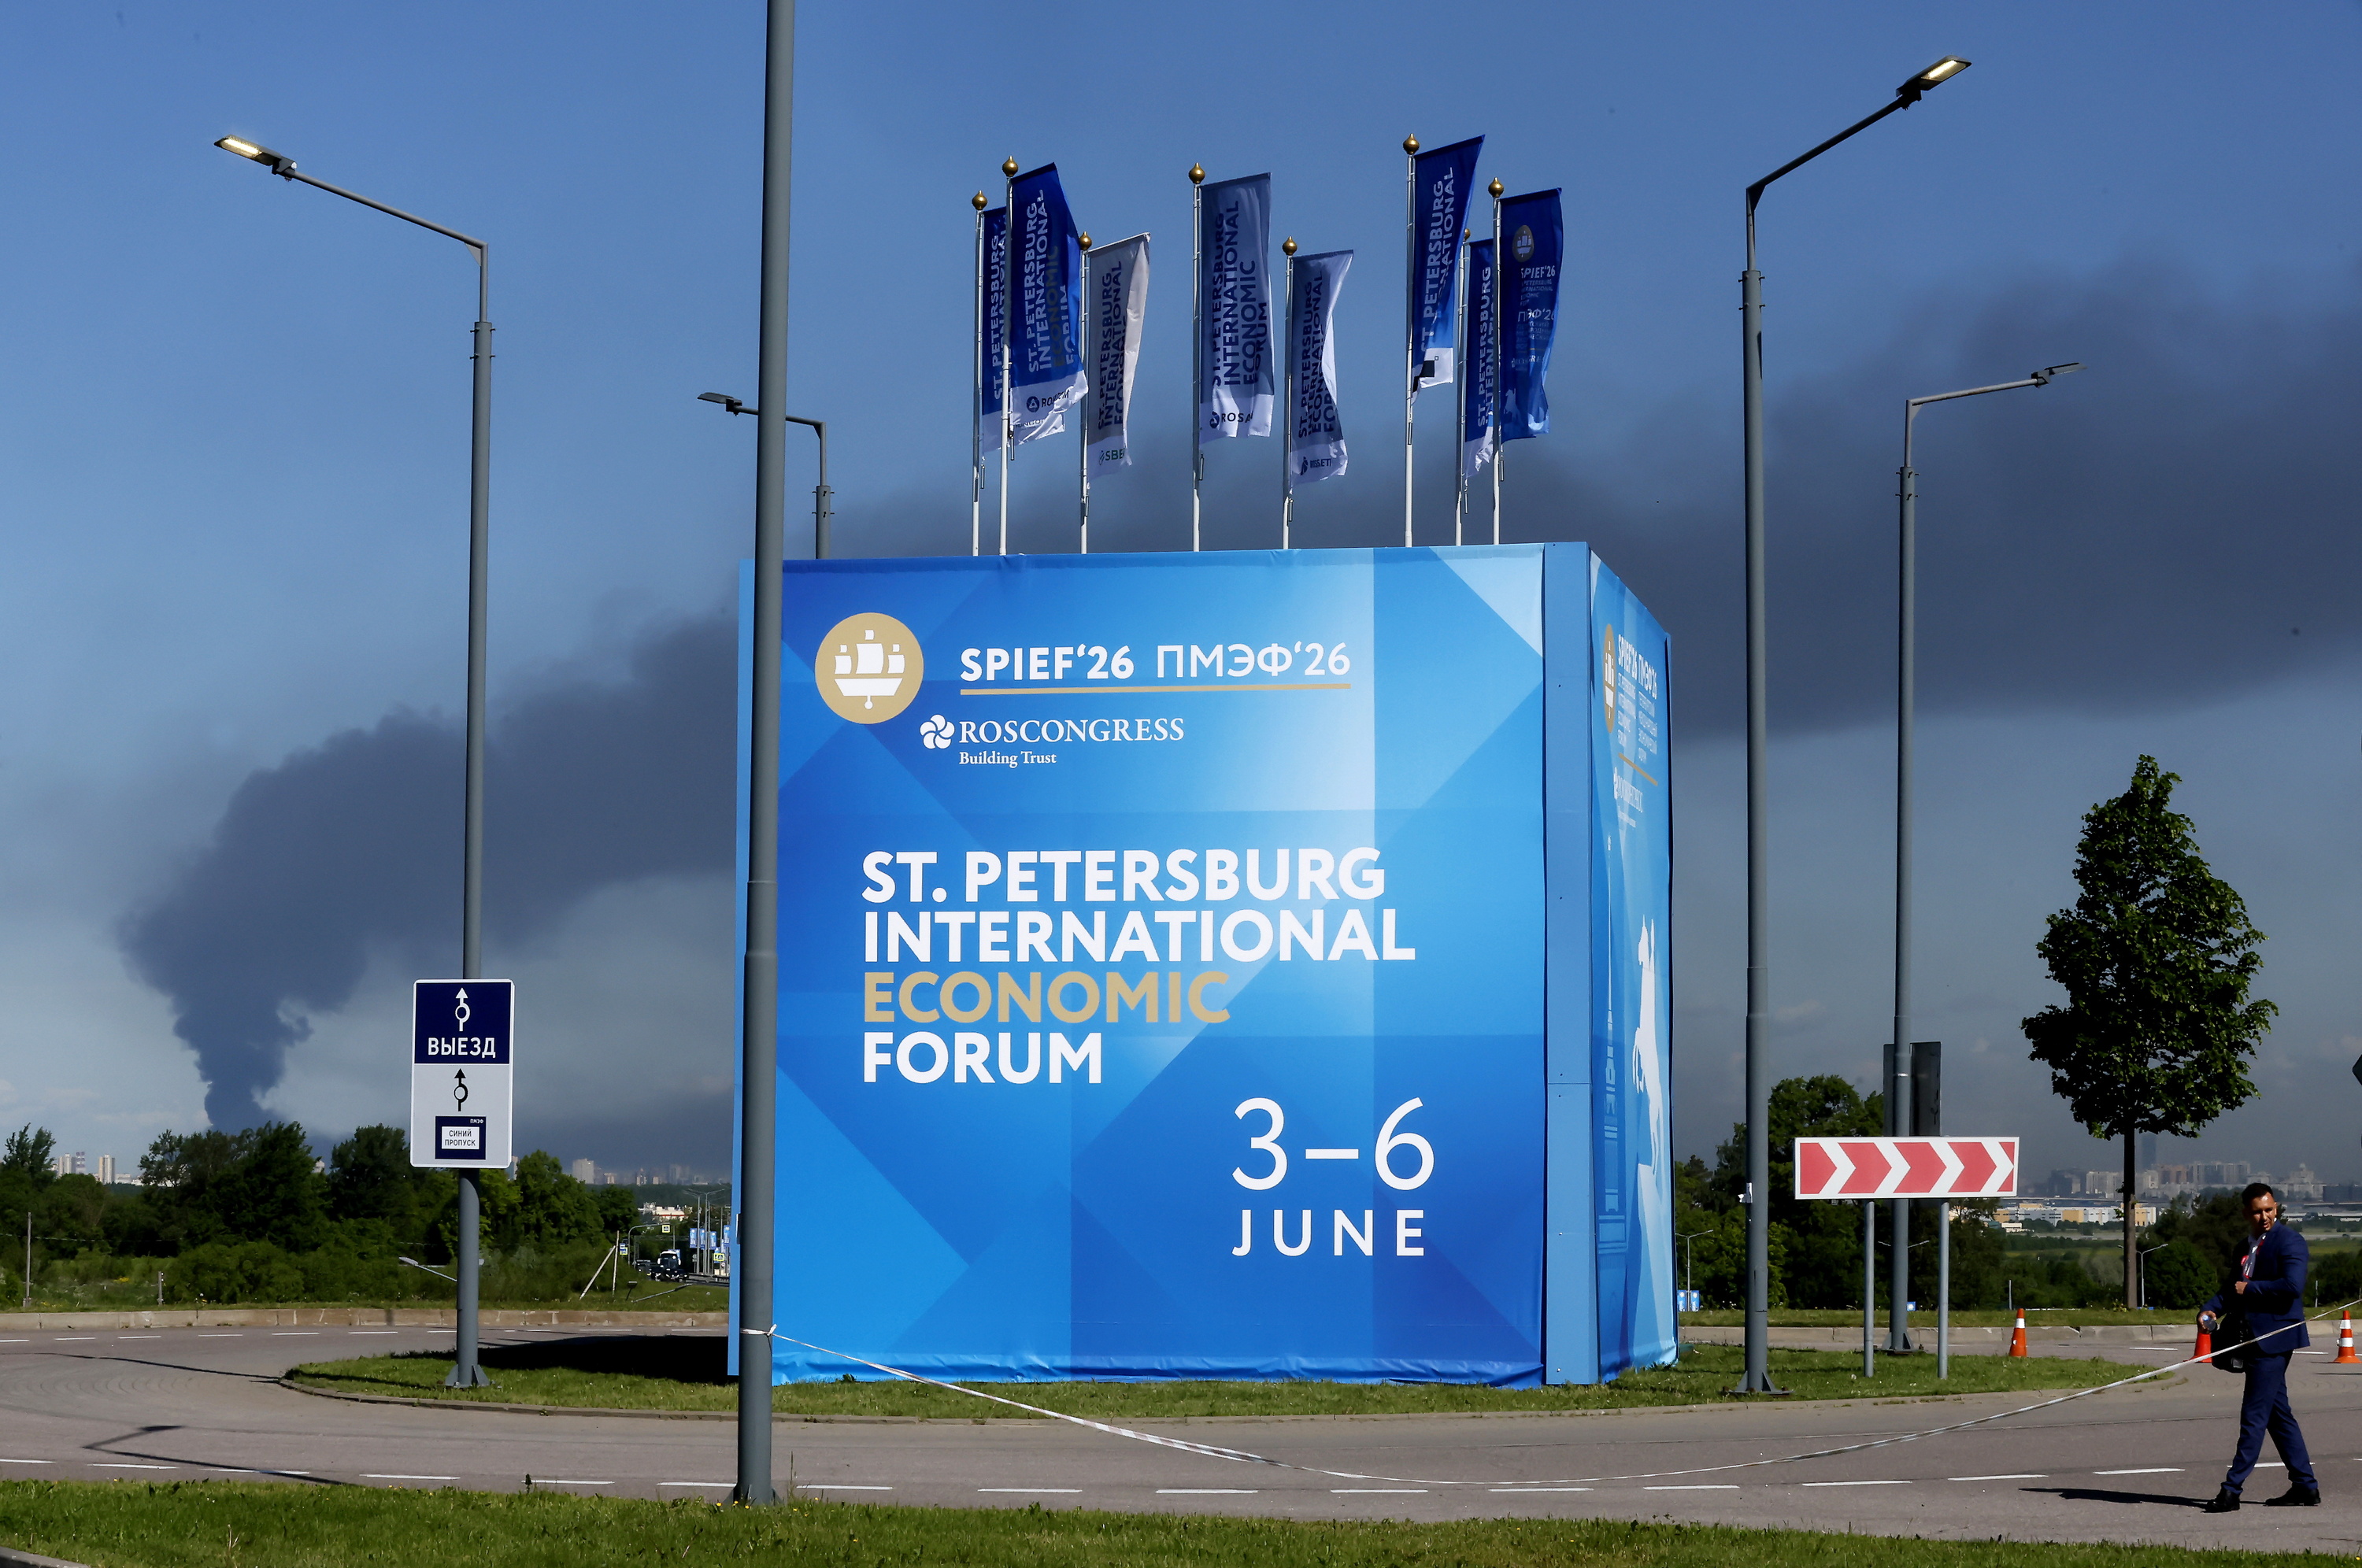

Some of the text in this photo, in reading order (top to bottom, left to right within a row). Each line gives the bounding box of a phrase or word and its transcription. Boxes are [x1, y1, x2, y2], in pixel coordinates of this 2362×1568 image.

[991, 235, 1002, 367] PETERSBURG
[1024, 202, 1039, 373] ST. PETERSBURG
[1035, 189, 1052, 370] INTERNATIONAL
[1046, 246, 1065, 367] ECONOMIC
[1212, 213, 1224, 353] PETERSBURG
[1223, 201, 1241, 385] INTERNATIONAL
[1423, 180, 1444, 318] PETERSBURG
[1100, 272, 1113, 398] PETERSBURG
[1104, 261, 1122, 427] INTERNATIONAL
[1240, 261, 1257, 385] ECONOMIC
[1301, 281, 1313, 407] PETERSBURG
[1479, 267, 1491, 395] PETERSBURG
[959, 718, 1185, 743] ROSCONGRESS
[959, 751, 1057, 768] Building Trust
[862, 847, 1385, 903] ST. PETERSBURG
[864, 908, 1416, 963] INTERNATIONAL
[428, 1037, 496, 1059] ВЫЕЗД
[864, 971, 1231, 1023] ECONOMIC
[864, 1032, 1101, 1084] FORUM
[449, 1129, 472, 1137] СИНИЙ
[1232, 1210, 1424, 1256] JUNE
